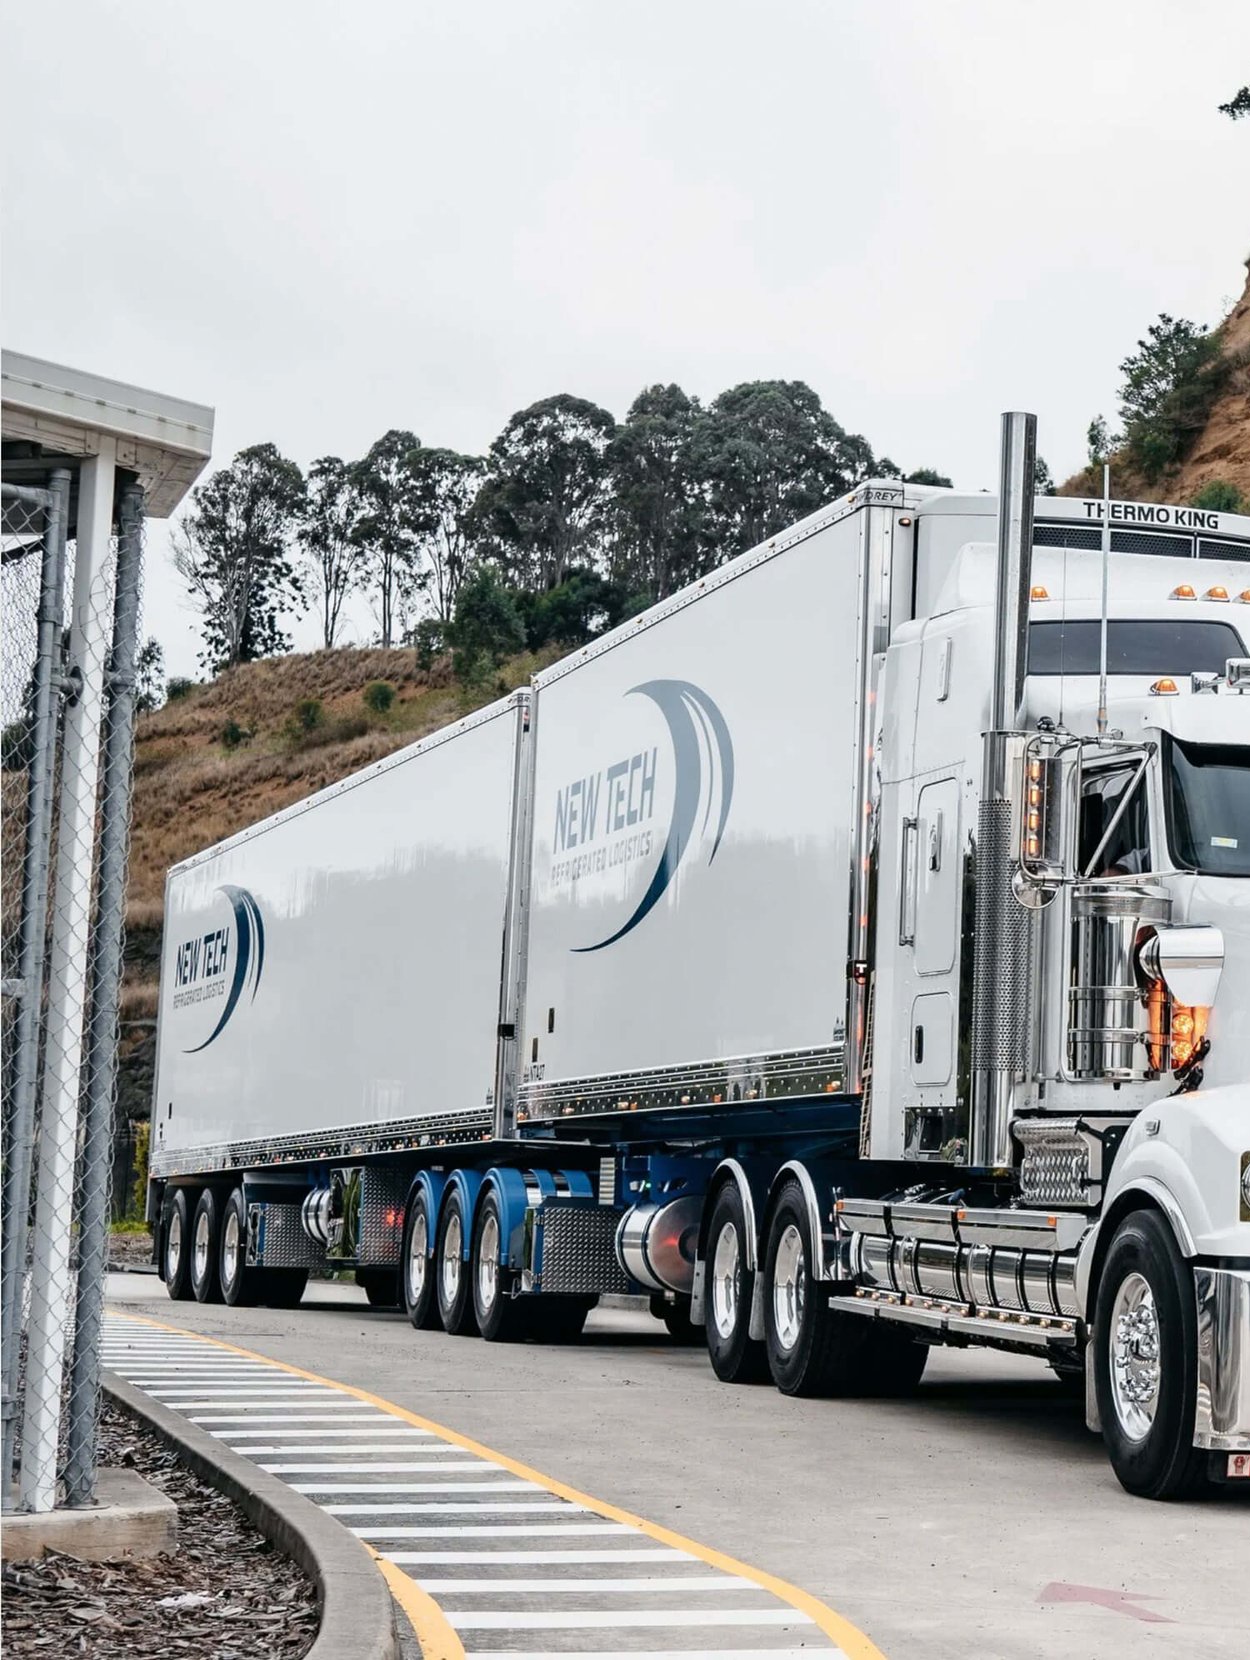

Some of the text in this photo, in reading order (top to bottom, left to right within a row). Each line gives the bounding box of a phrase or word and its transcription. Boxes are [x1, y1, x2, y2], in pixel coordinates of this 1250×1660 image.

[1083, 502, 1219, 530] THERMO KING
[553, 747, 657, 855] NEW TECH
[608, 830, 652, 868] LOGISTICS
[175, 927, 230, 989] NEW TECH
